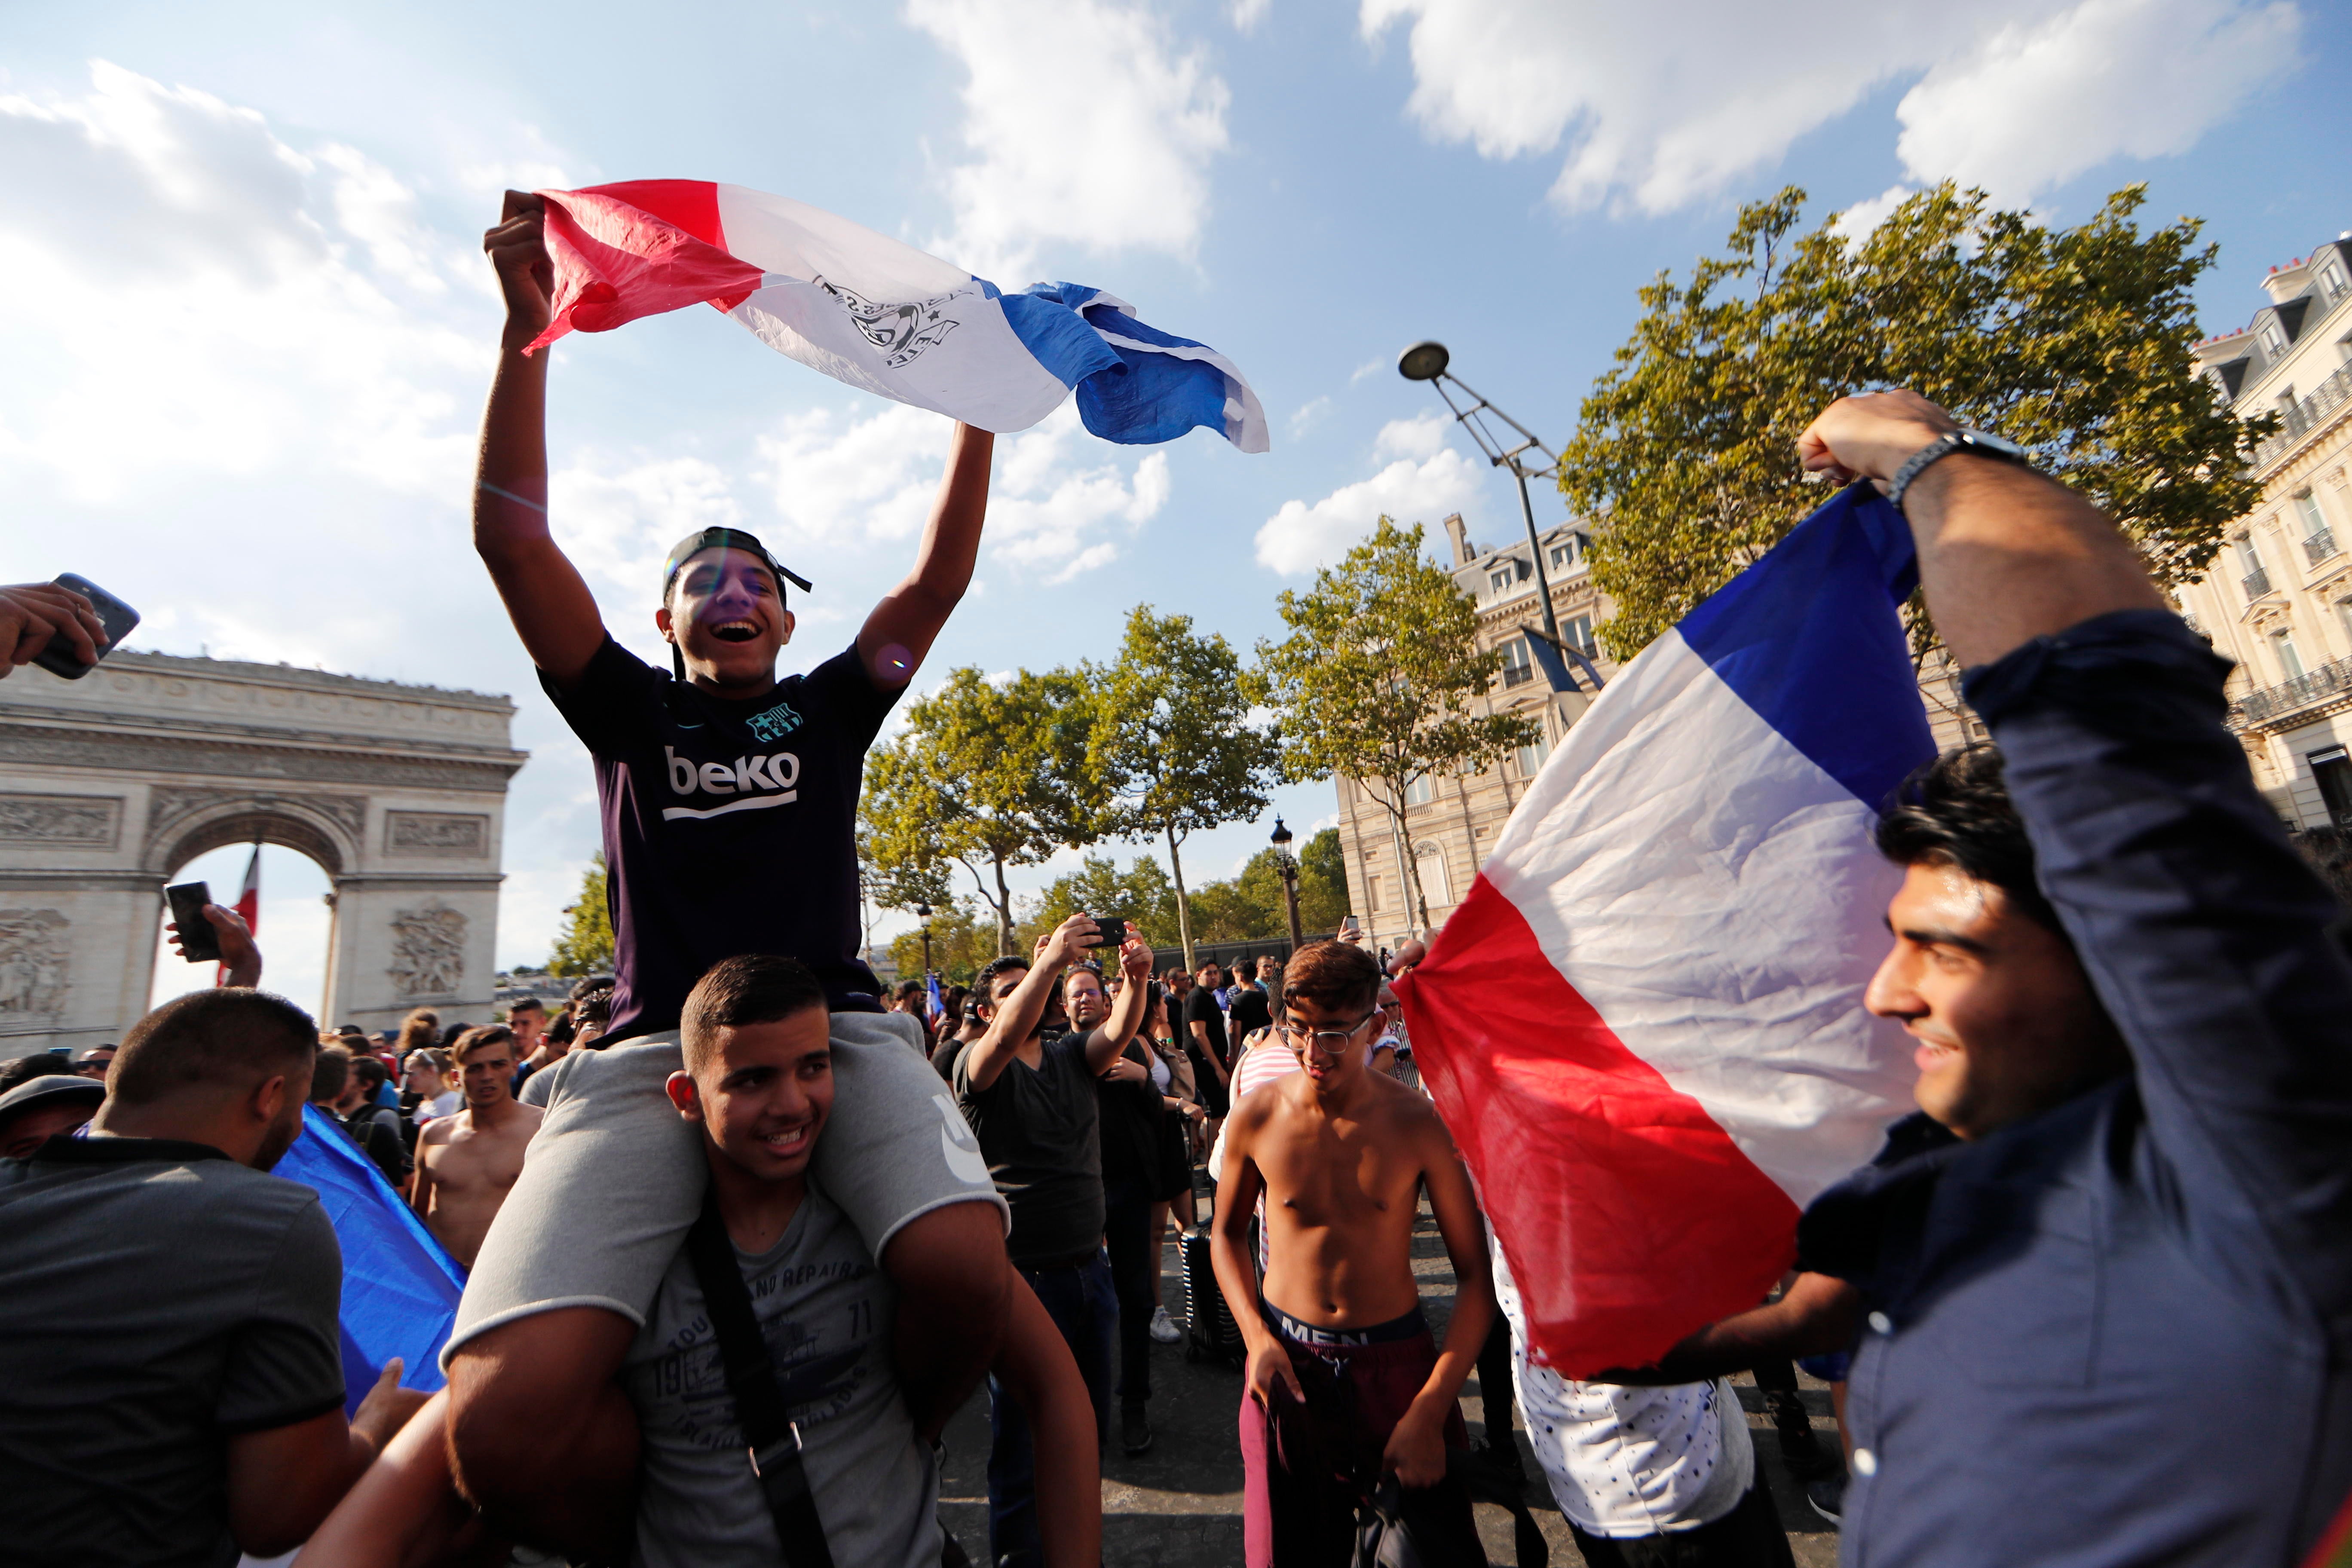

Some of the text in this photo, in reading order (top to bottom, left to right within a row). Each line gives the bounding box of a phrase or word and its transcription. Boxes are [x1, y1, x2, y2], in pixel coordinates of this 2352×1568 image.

[665, 745, 799, 795] beko
[668, 1261, 867, 1351] TOU ND REPAIRS
[848, 1298, 872, 1338] 71
